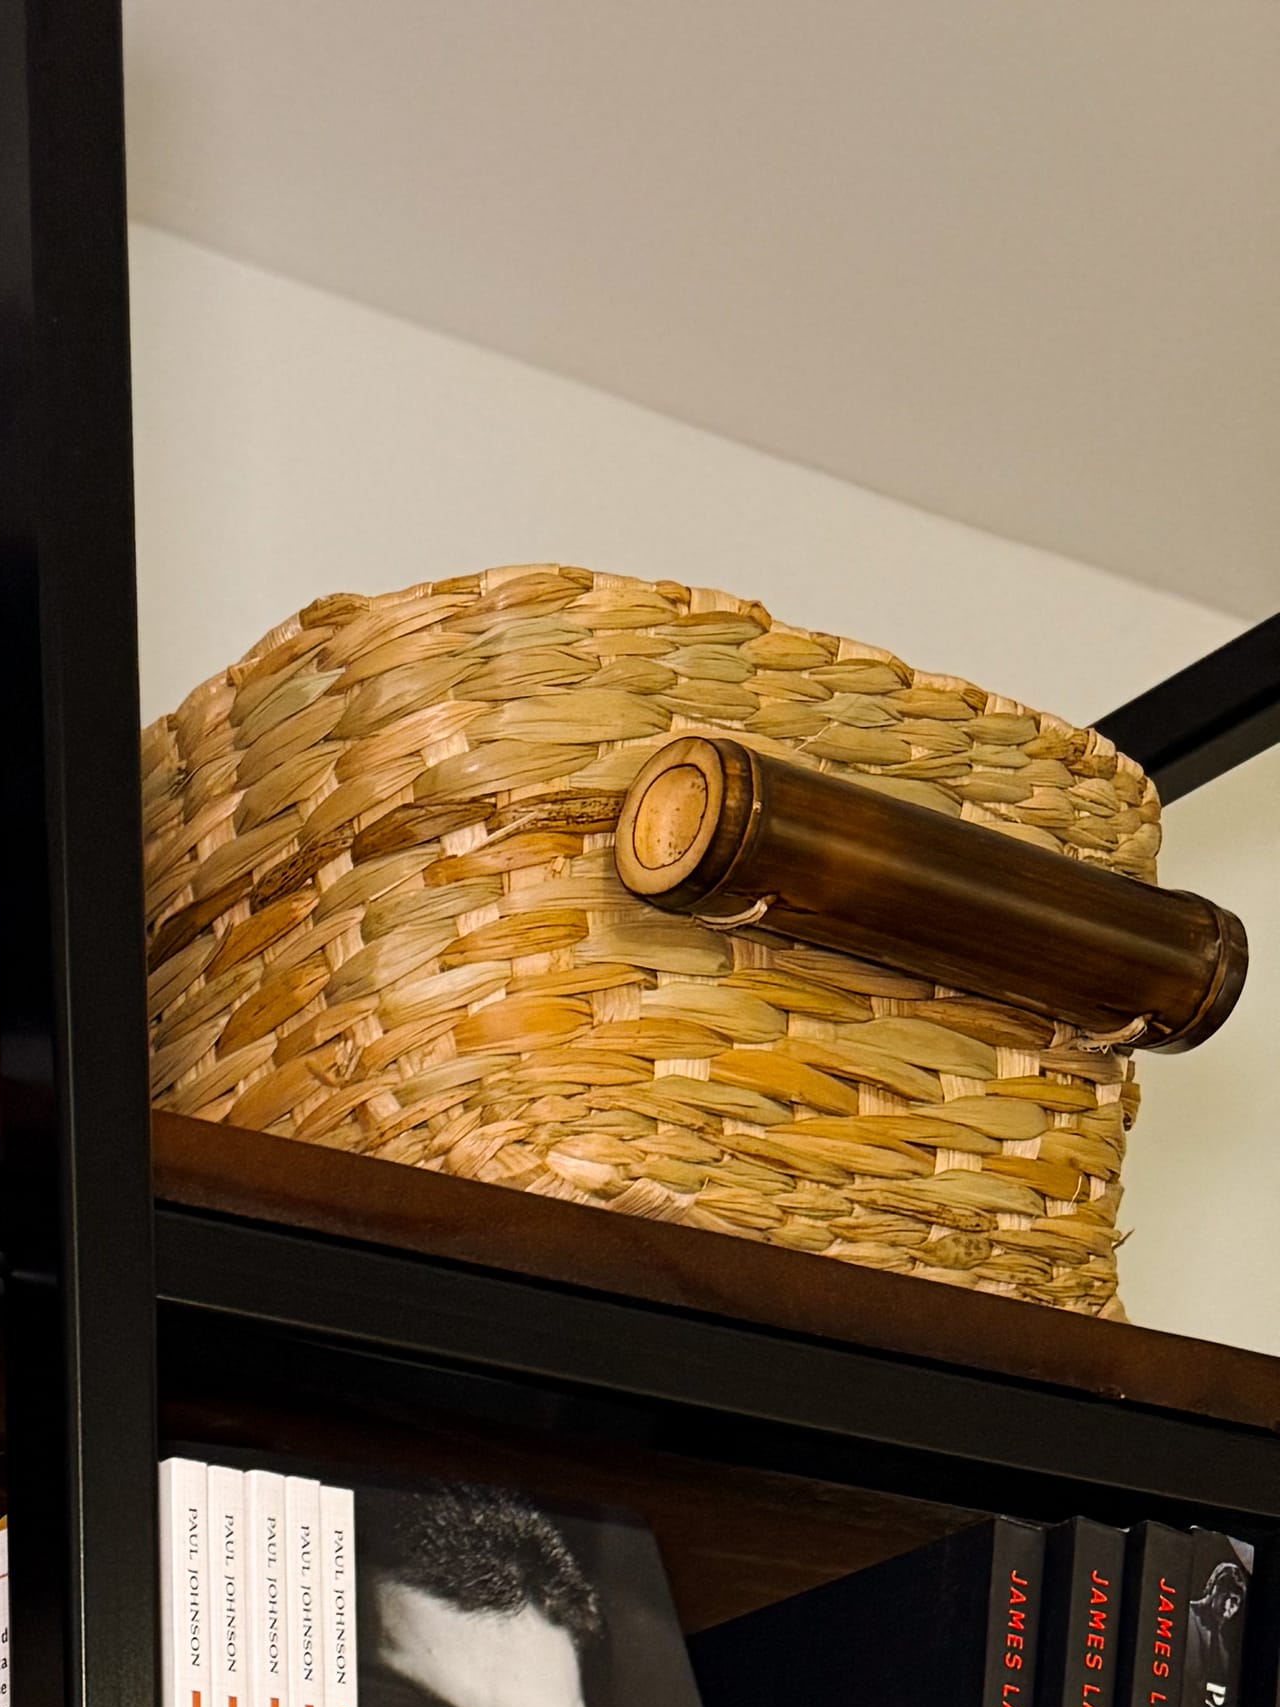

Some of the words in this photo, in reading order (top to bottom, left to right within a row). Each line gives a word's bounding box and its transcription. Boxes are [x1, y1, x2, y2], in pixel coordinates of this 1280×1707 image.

[188, 1508, 197, 1559] PAUL
[188, 1569, 199, 1666] JOHNSON
[1004, 1570, 1027, 1669] JAMES
